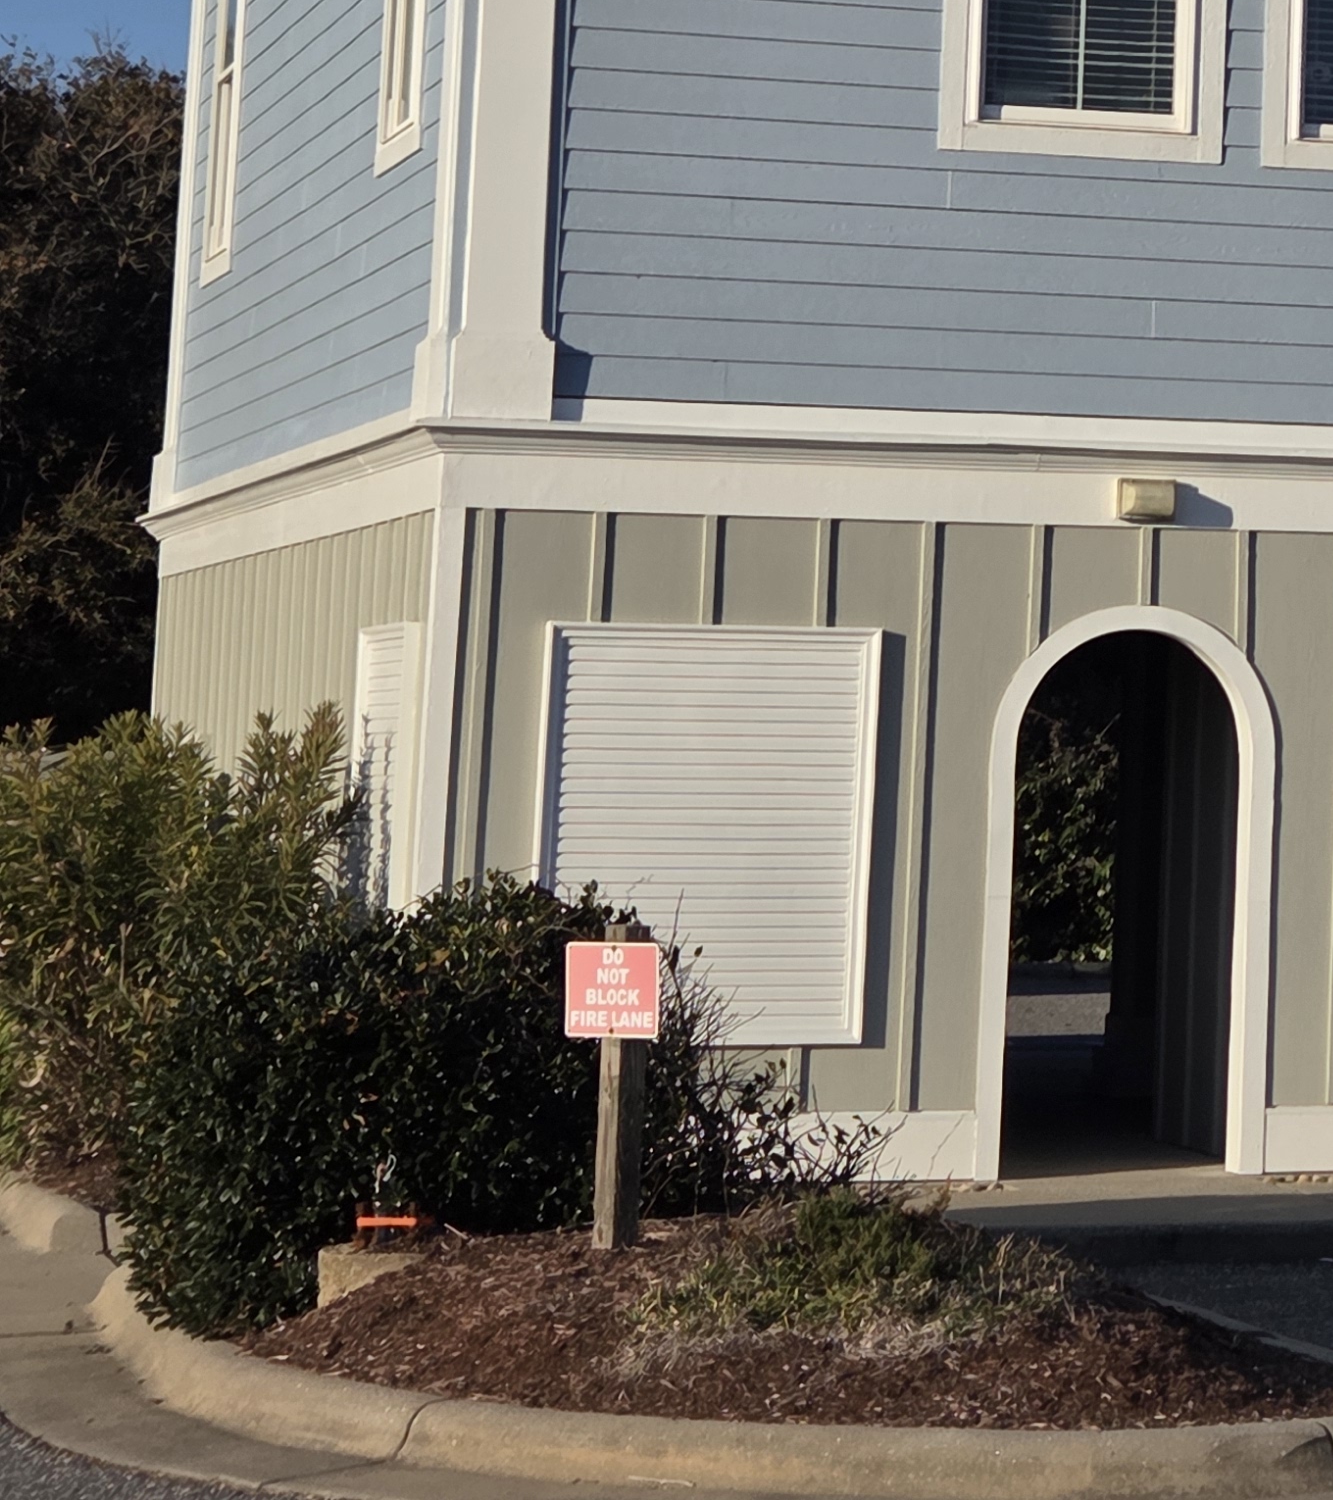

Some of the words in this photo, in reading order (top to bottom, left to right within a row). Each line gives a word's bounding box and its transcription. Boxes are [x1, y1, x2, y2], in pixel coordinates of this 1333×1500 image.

[602, 947, 624, 965] DO
[597, 967, 630, 985] NOT
[585, 988, 639, 1005] BLOCK
[570, 1010, 608, 1028] FIRE
[611, 1010, 654, 1029] LANE
